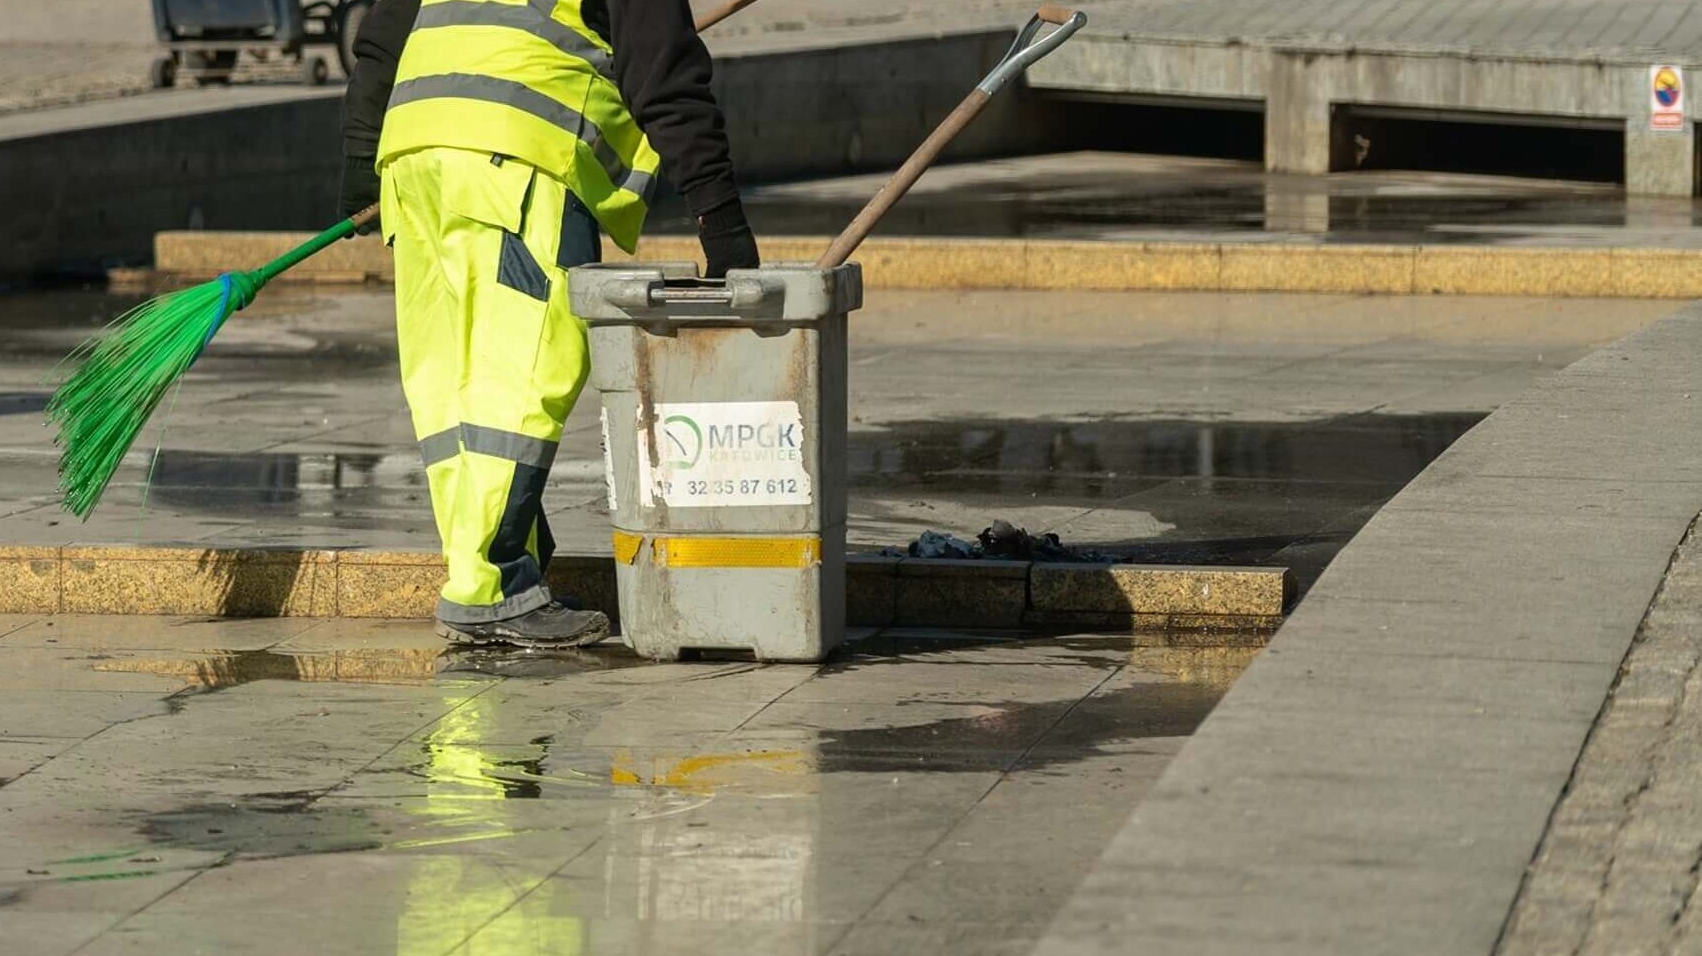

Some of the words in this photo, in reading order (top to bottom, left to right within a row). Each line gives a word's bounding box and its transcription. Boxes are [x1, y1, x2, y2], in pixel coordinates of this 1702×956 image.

[709, 423, 796, 448] MPGK
[687, 481, 708, 495] 32
[714, 480, 734, 494] 35
[740, 480, 760, 494] 87
[766, 479, 797, 494] 612
